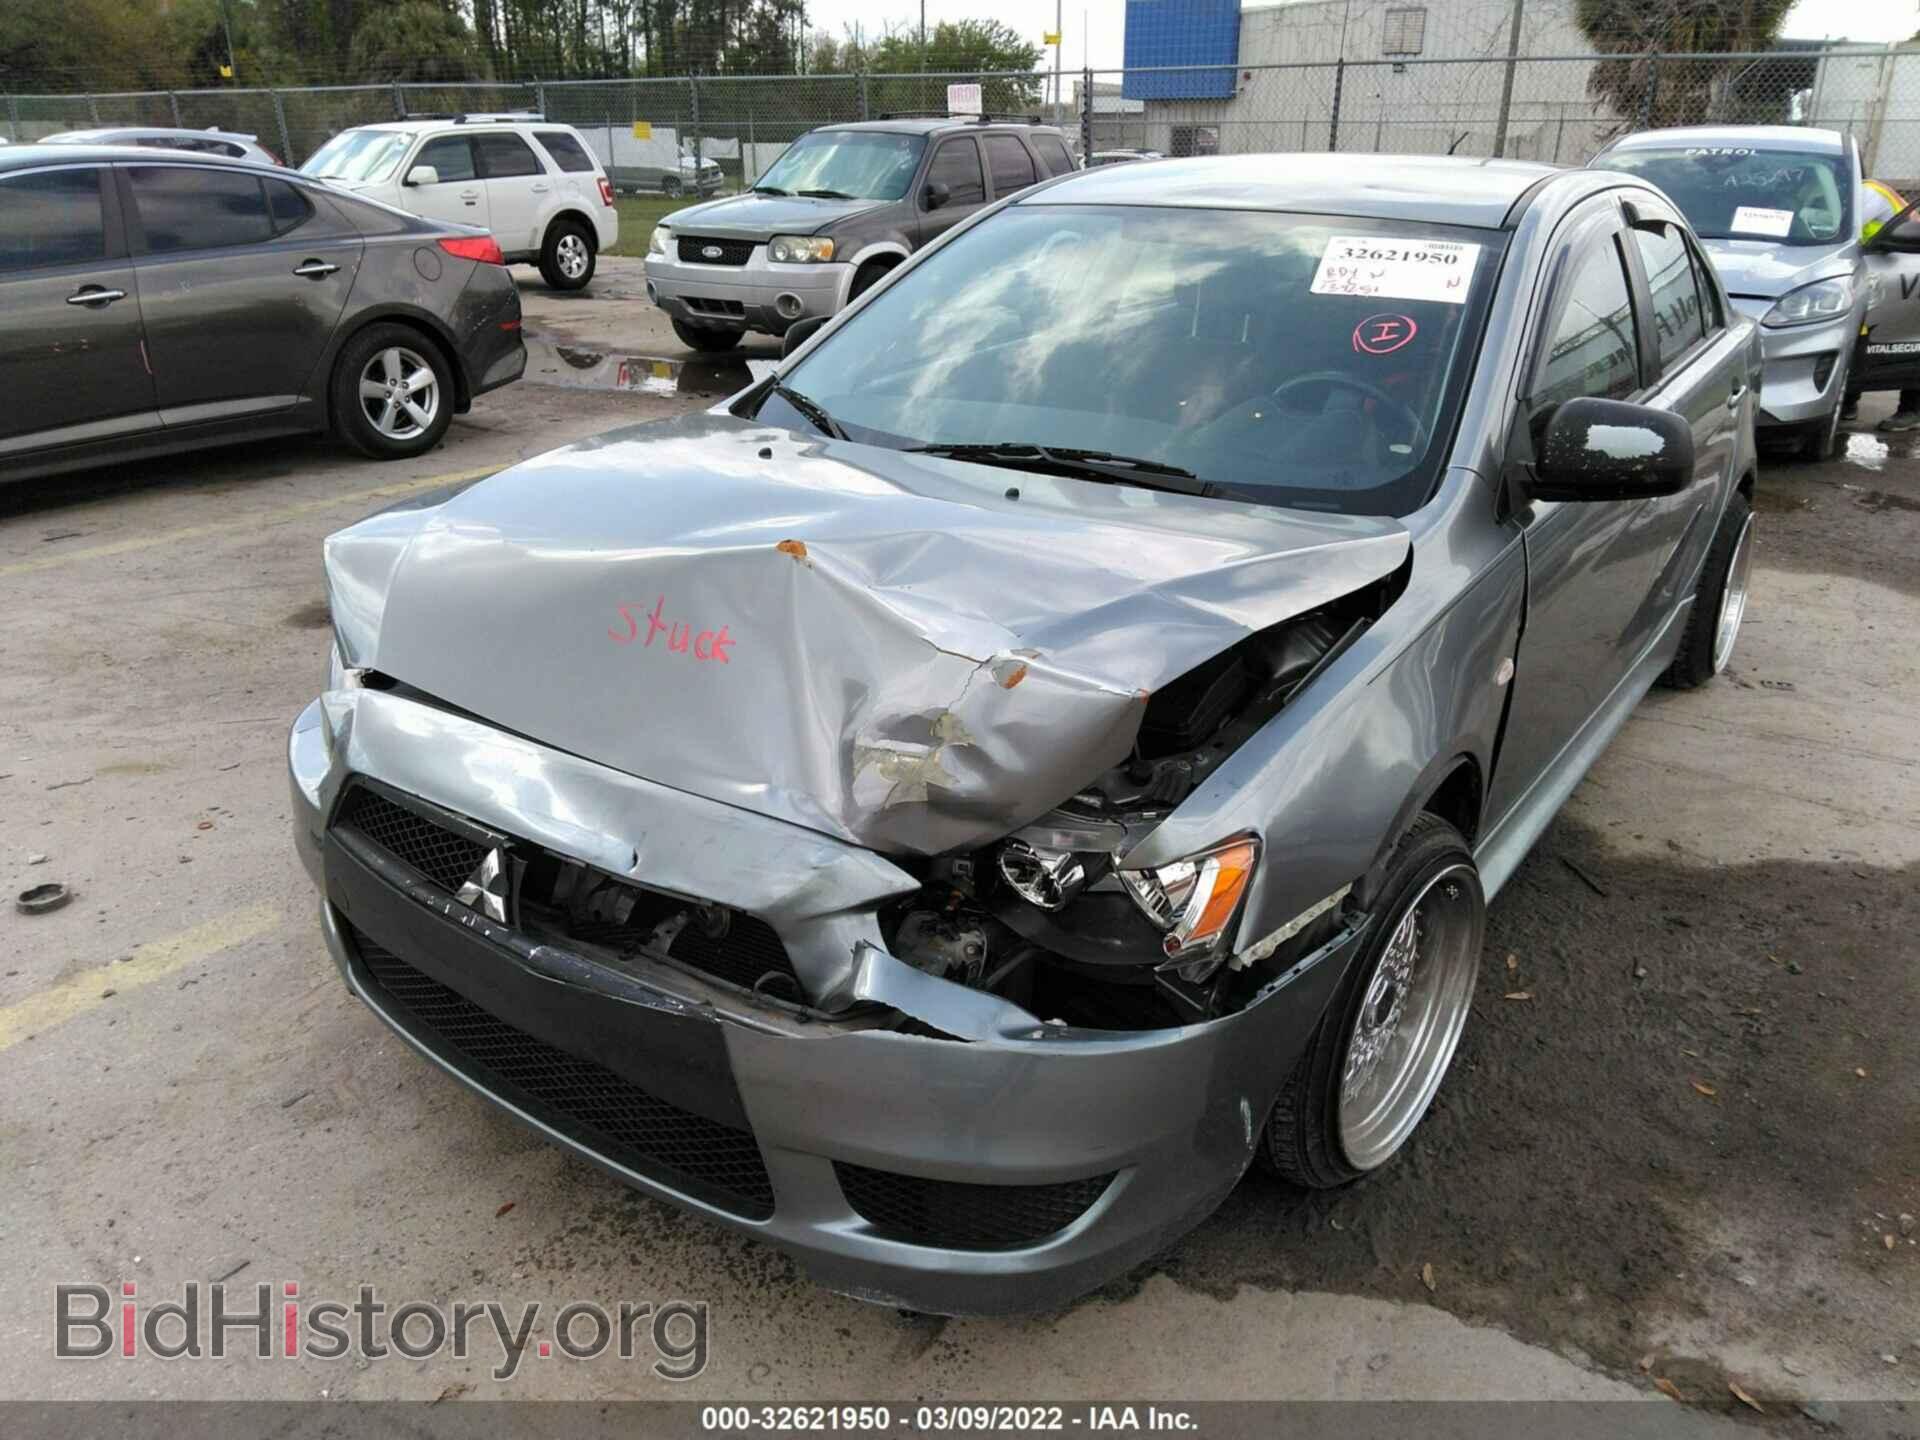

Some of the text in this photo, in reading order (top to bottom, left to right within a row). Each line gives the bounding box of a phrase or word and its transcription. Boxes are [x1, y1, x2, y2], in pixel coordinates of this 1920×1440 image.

[1684, 148, 1760, 157] PATROL
[1340, 247, 1458, 265] 32621950
[1900, 273, 1920, 300] V
[607, 593, 736, 664] Stuck
